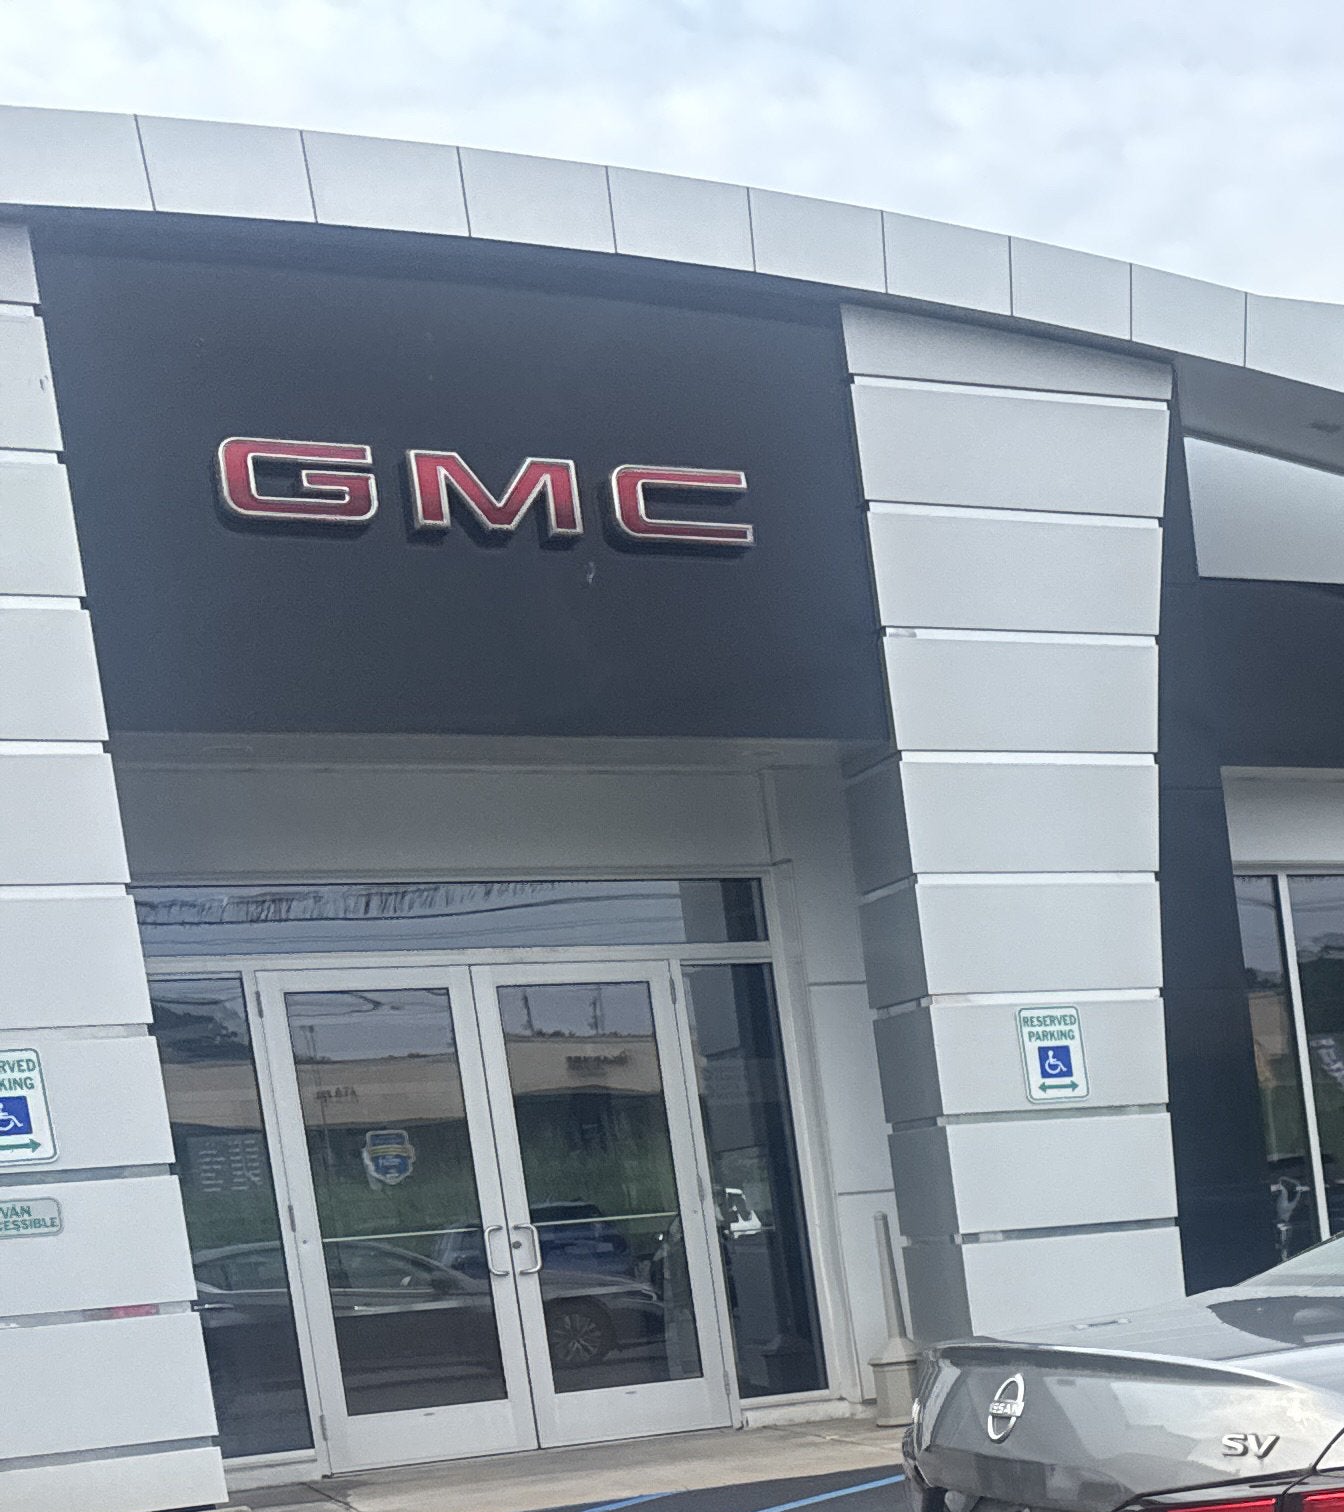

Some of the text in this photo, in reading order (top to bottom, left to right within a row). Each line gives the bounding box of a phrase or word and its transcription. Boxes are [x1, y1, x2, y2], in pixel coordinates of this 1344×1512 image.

[218, 436, 755, 546] GMC
[1022, 1014, 1077, 1028] RESERVED
[1028, 1029, 1075, 1042] PARKING
[0, 1204, 32, 1219] VAN
[1221, 1433, 1280, 1459] SV
